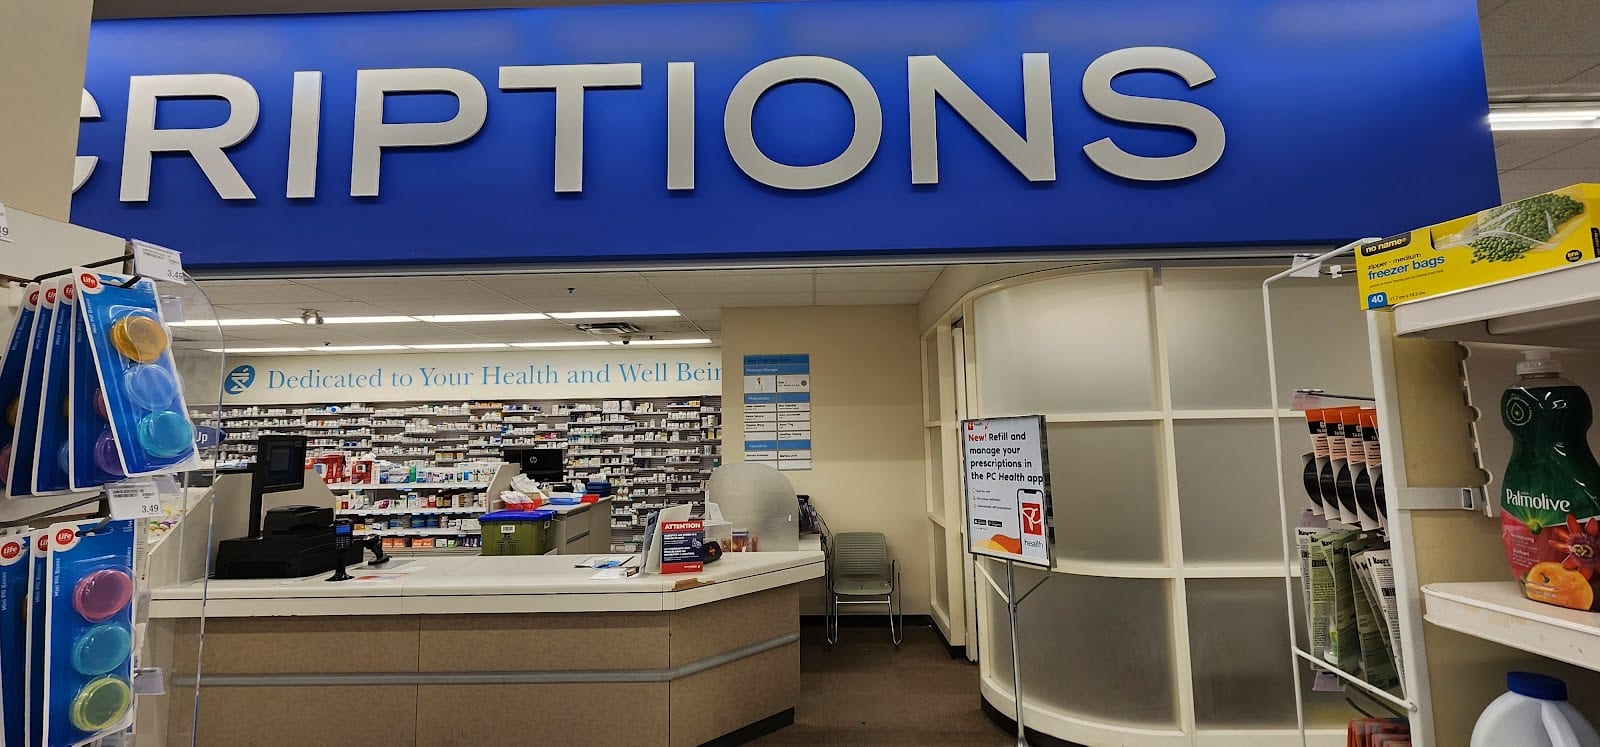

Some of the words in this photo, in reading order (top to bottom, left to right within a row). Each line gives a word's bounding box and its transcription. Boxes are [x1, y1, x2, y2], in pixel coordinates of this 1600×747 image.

[1368, 261, 1387, 270] zipper
[1393, 253, 1421, 263] medium
[1368, 264, 1409, 280] freezer
[1412, 256, 1445, 270] bags
[168, 270, 183, 279] 3.49
[82, 275, 95, 286] Life
[1372, 295, 1384, 303] 40
[268, 368, 382, 389] Dedicated
[392, 372, 413, 387] to
[420, 367, 474, 387] Your
[482, 363, 558, 385] Health
[567, 364, 610, 384] and
[618, 362, 667, 382] Well
[989, 432, 1008, 440] Refill
[1010, 432, 1026, 440] and
[970, 448, 1000, 456] manage
[1003, 448, 1020, 456] your
[970, 459, 1022, 470] prescriptions
[1024, 459, 1032, 468] in
[999, 473, 1024, 481] Health
[1027, 476, 1043, 485] app
[1506, 488, 1570, 512] Palmolive
[142, 505, 158, 513] 3.49
[1024, 540, 1043, 548] health
[3, 546, 18, 554] Life
